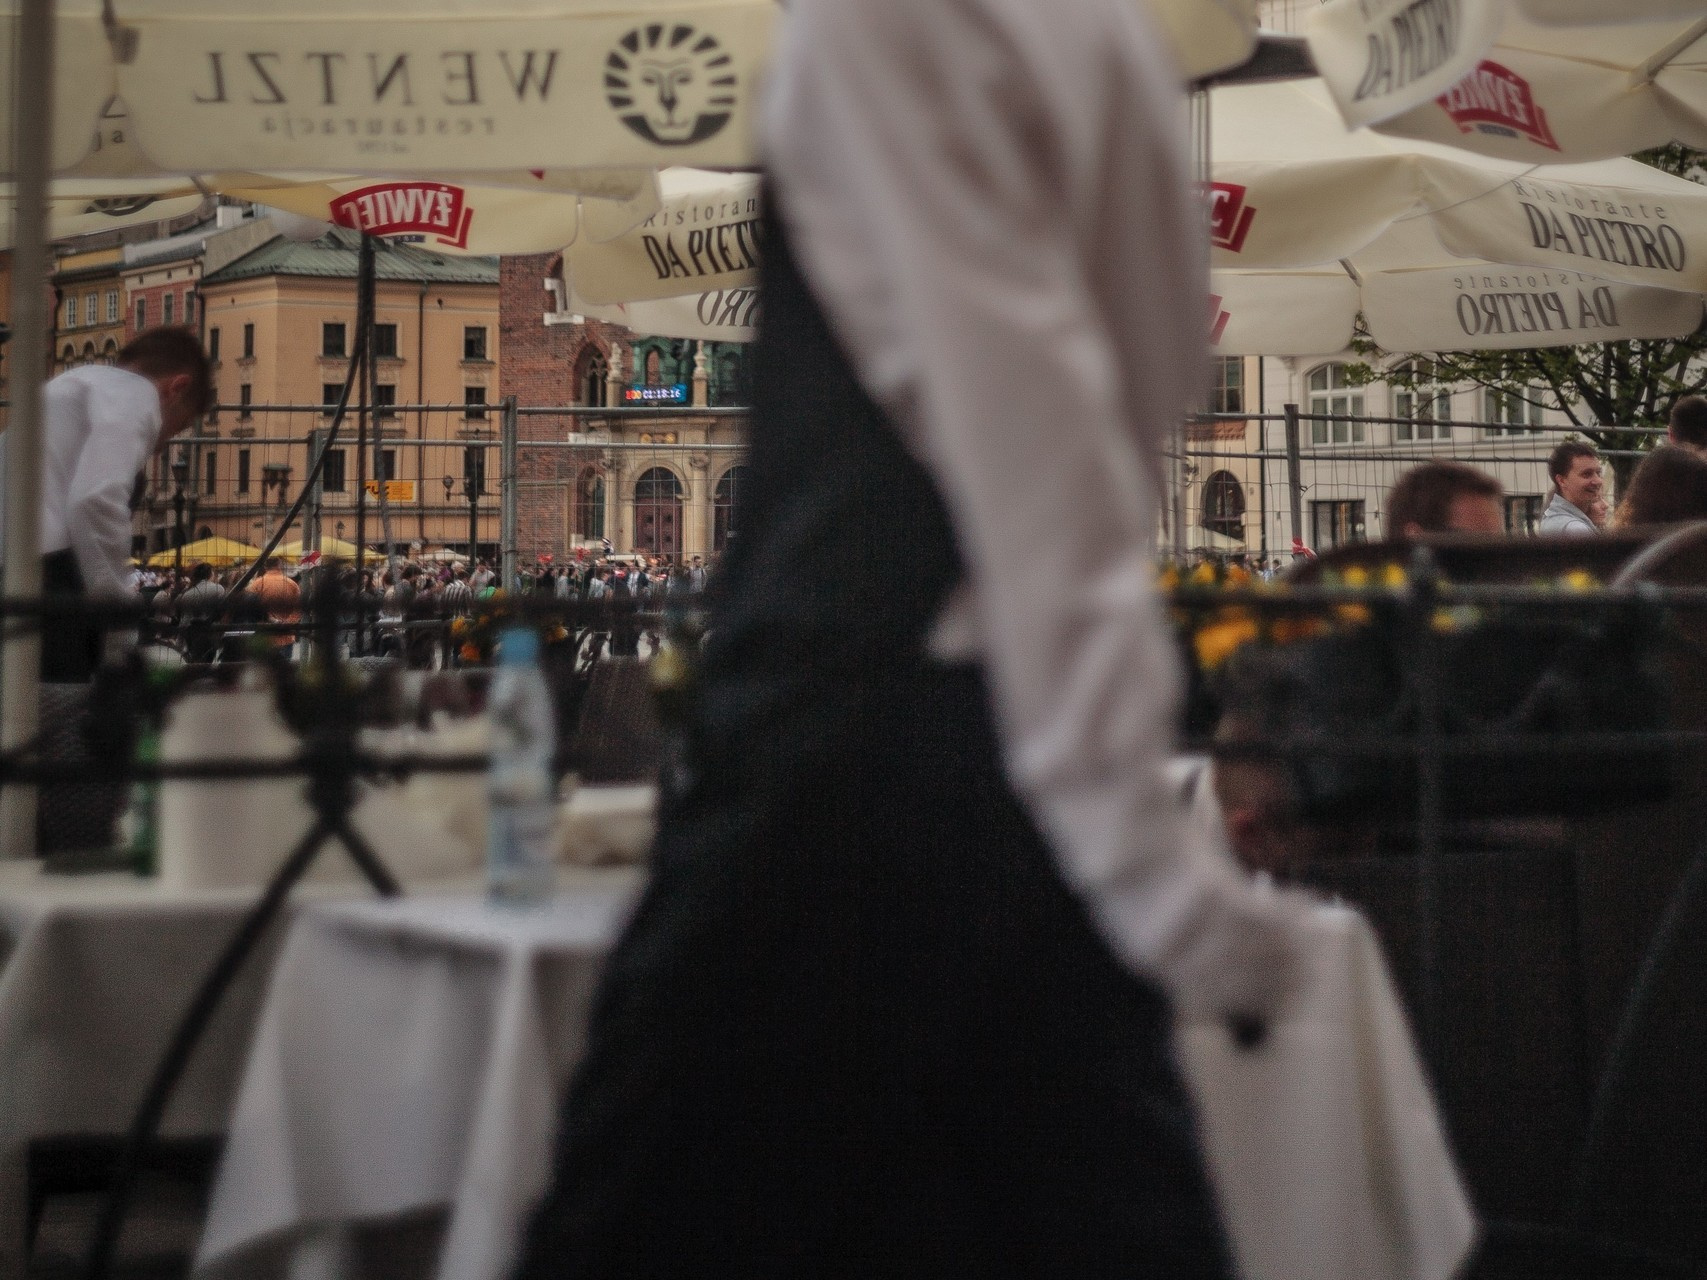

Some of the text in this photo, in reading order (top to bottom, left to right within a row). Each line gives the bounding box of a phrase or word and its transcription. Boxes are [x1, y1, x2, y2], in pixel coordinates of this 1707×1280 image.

[1511, 179, 1667, 220] Ristorante
[642, 231, 691, 280] DA
[1519, 201, 1686, 272] DA PIETRO
